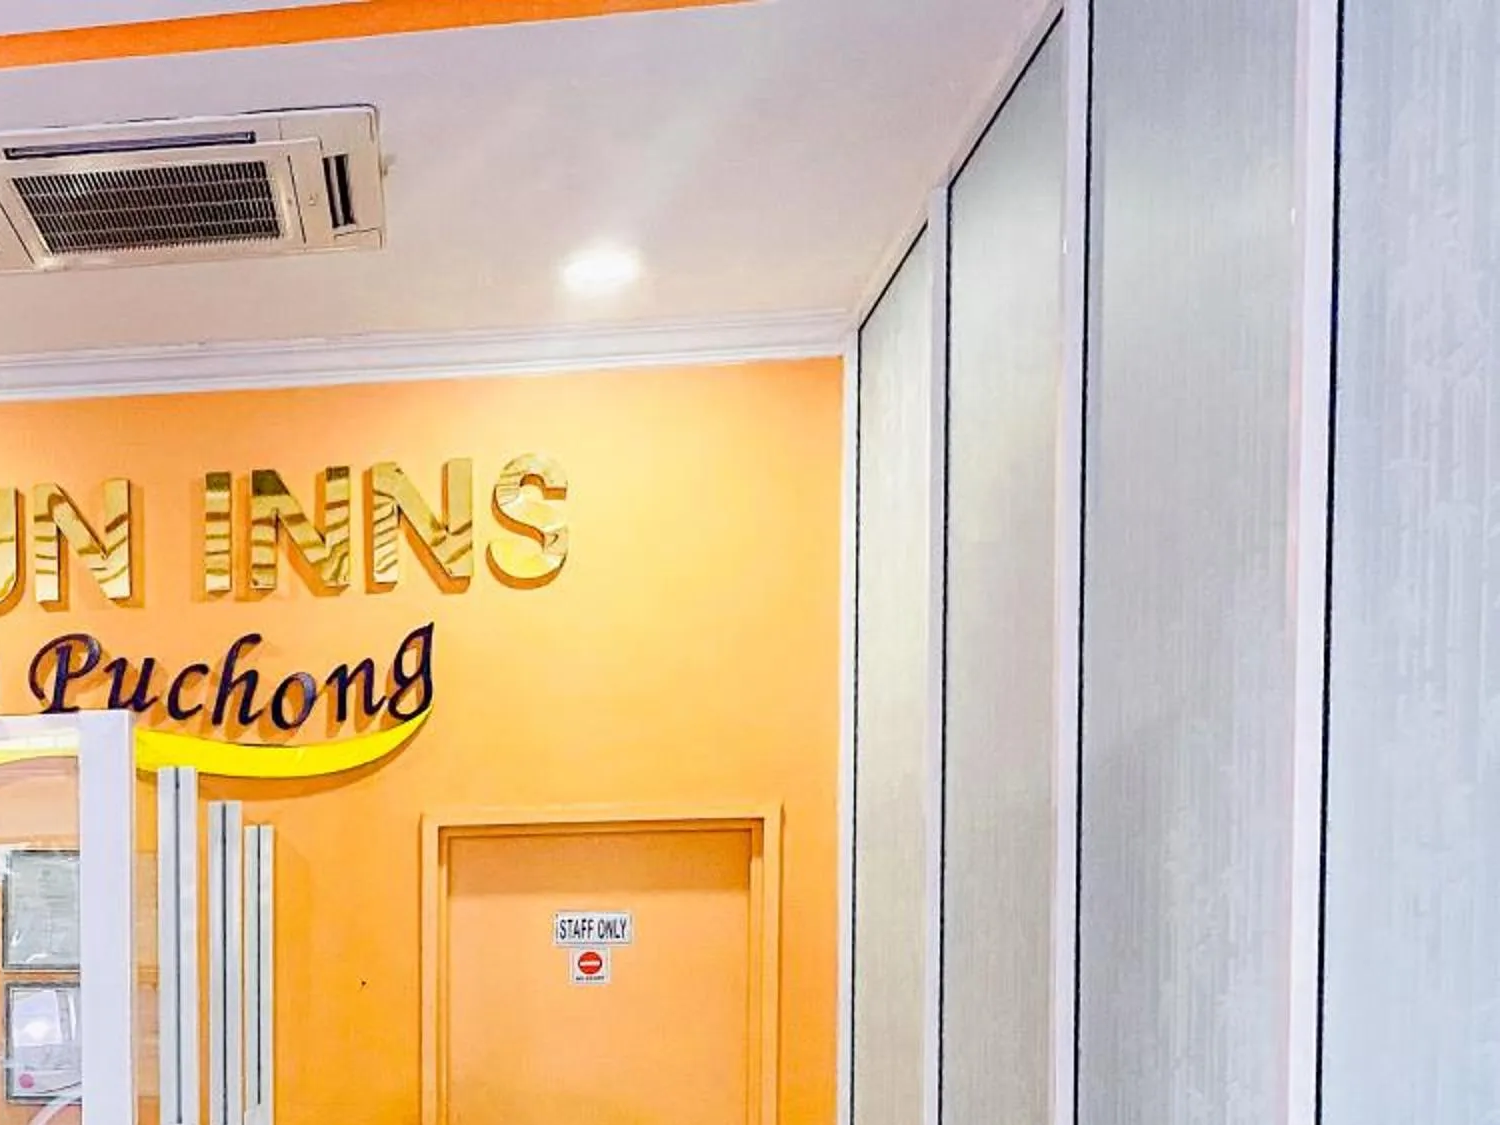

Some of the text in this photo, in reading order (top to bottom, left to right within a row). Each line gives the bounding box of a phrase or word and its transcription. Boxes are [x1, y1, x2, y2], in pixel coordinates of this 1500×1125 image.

[198, 453, 570, 594] INNS
[28, 622, 436, 729] Puchong
[559, 918, 627, 939] STAFF ONLY
